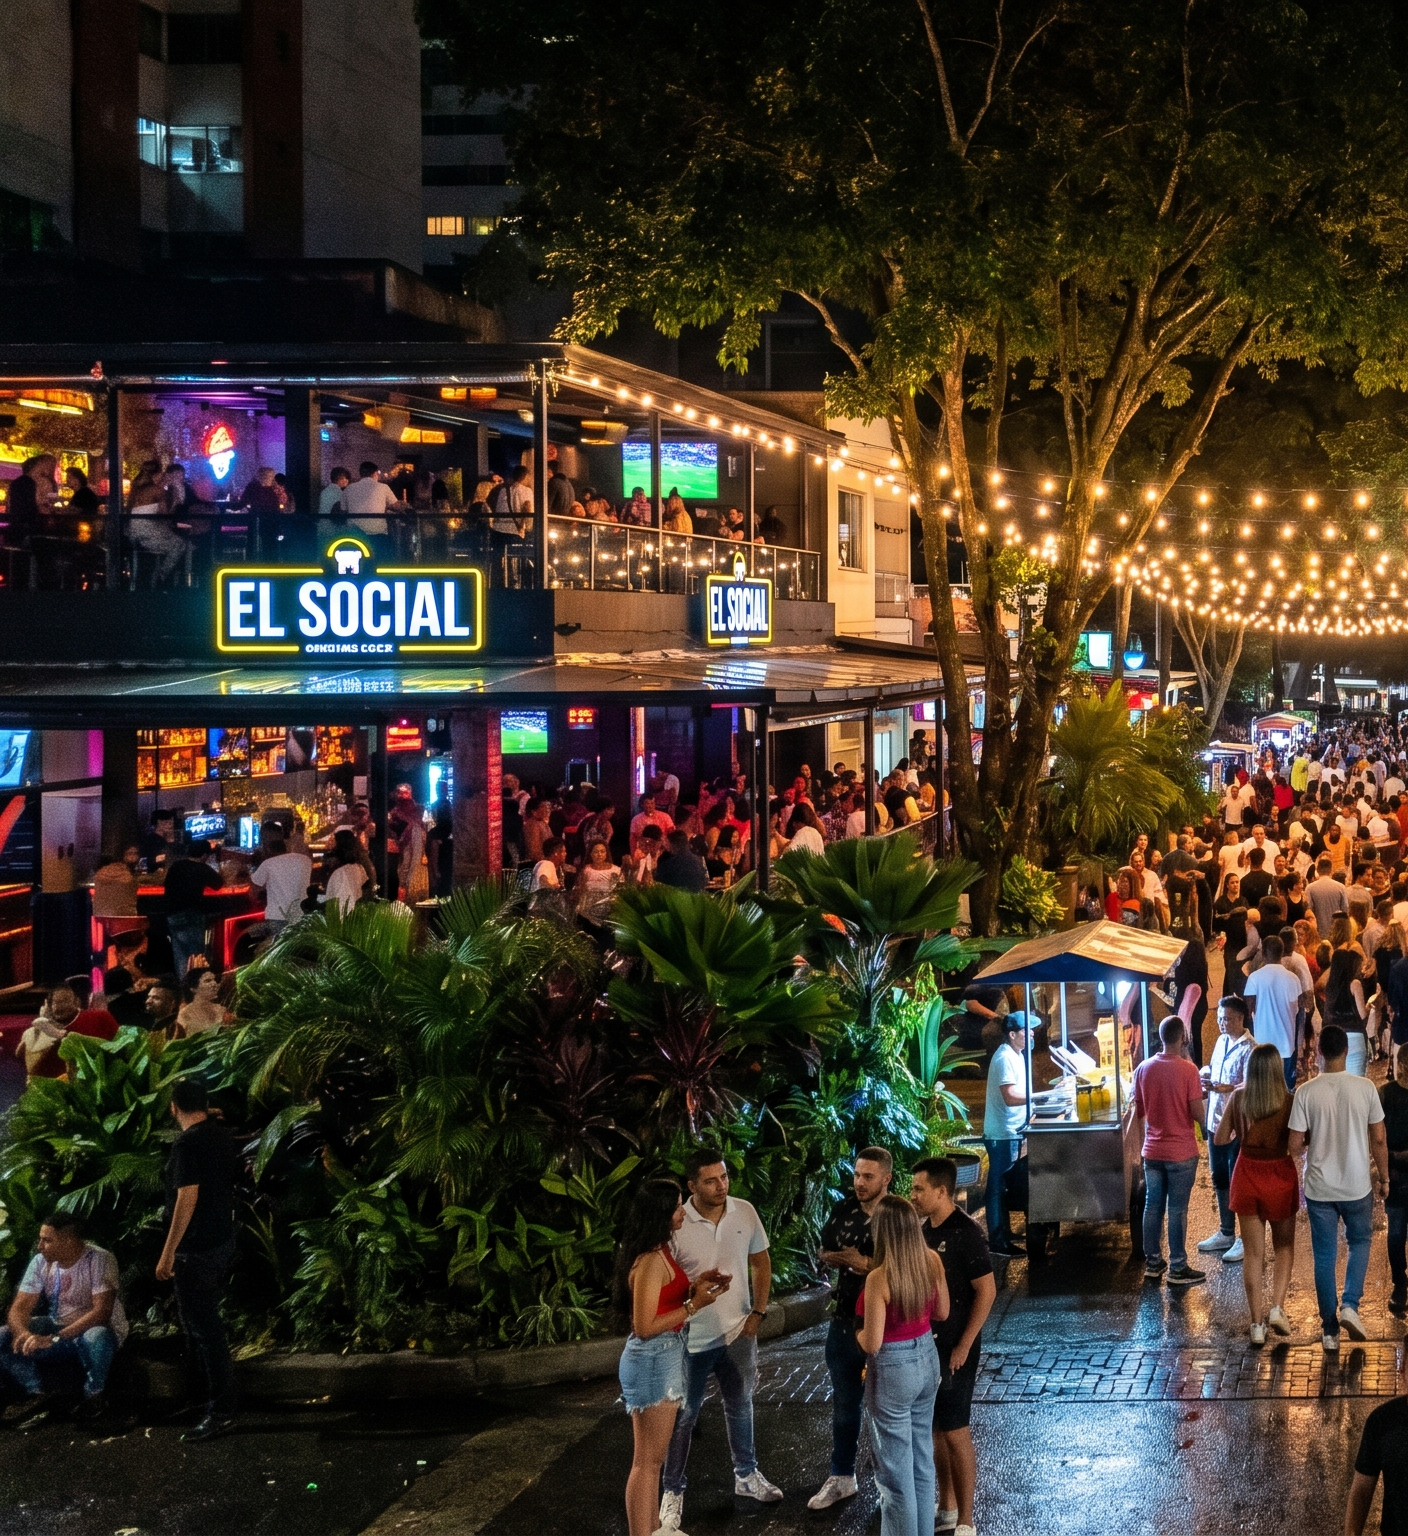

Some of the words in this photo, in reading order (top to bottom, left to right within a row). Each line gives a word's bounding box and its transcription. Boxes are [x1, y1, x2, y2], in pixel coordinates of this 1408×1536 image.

[229, 581, 285, 637] EL
[299, 581, 470, 637] SOCIAL
[710, 586, 726, 632] EL
[727, 586, 768, 632] SOCIAL
